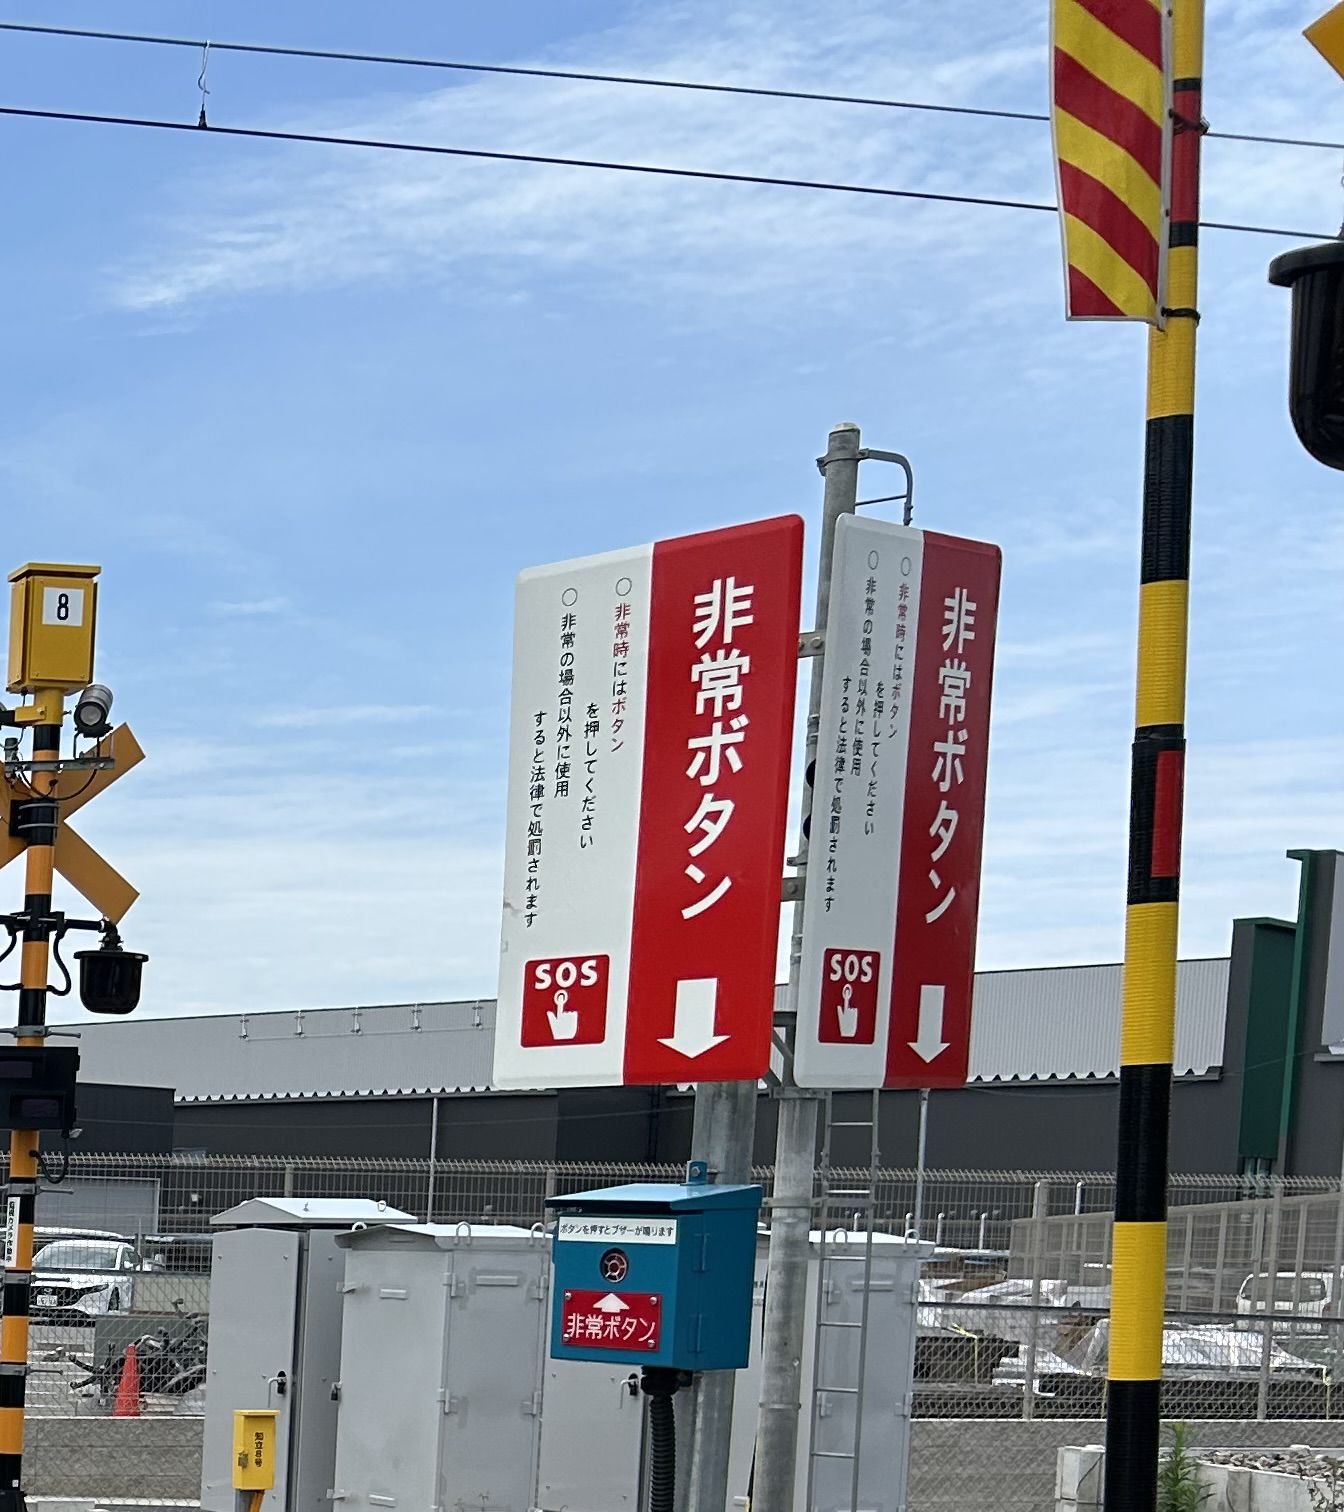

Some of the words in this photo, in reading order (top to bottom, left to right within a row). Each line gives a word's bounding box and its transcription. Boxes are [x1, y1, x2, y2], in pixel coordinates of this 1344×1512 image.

[57, 593, 69, 620] 8
[524, 710, 547, 929] すると法律で処罰されます
[580, 702, 600, 849] を押してください
[681, 576, 754, 920] 非常ボタン
[824, 675, 852, 912] すると法律で処罰されます
[864, 680, 885, 835] を押してください
[925, 586, 977, 924] 非常ボタン
[535, 959, 598, 990] SOS
[830, 953, 873, 983] SOS
[560, 1223, 674, 1237] ボタンを押すとブザーが鳴ります
[567, 1313, 655, 1342] 非常ボタン
